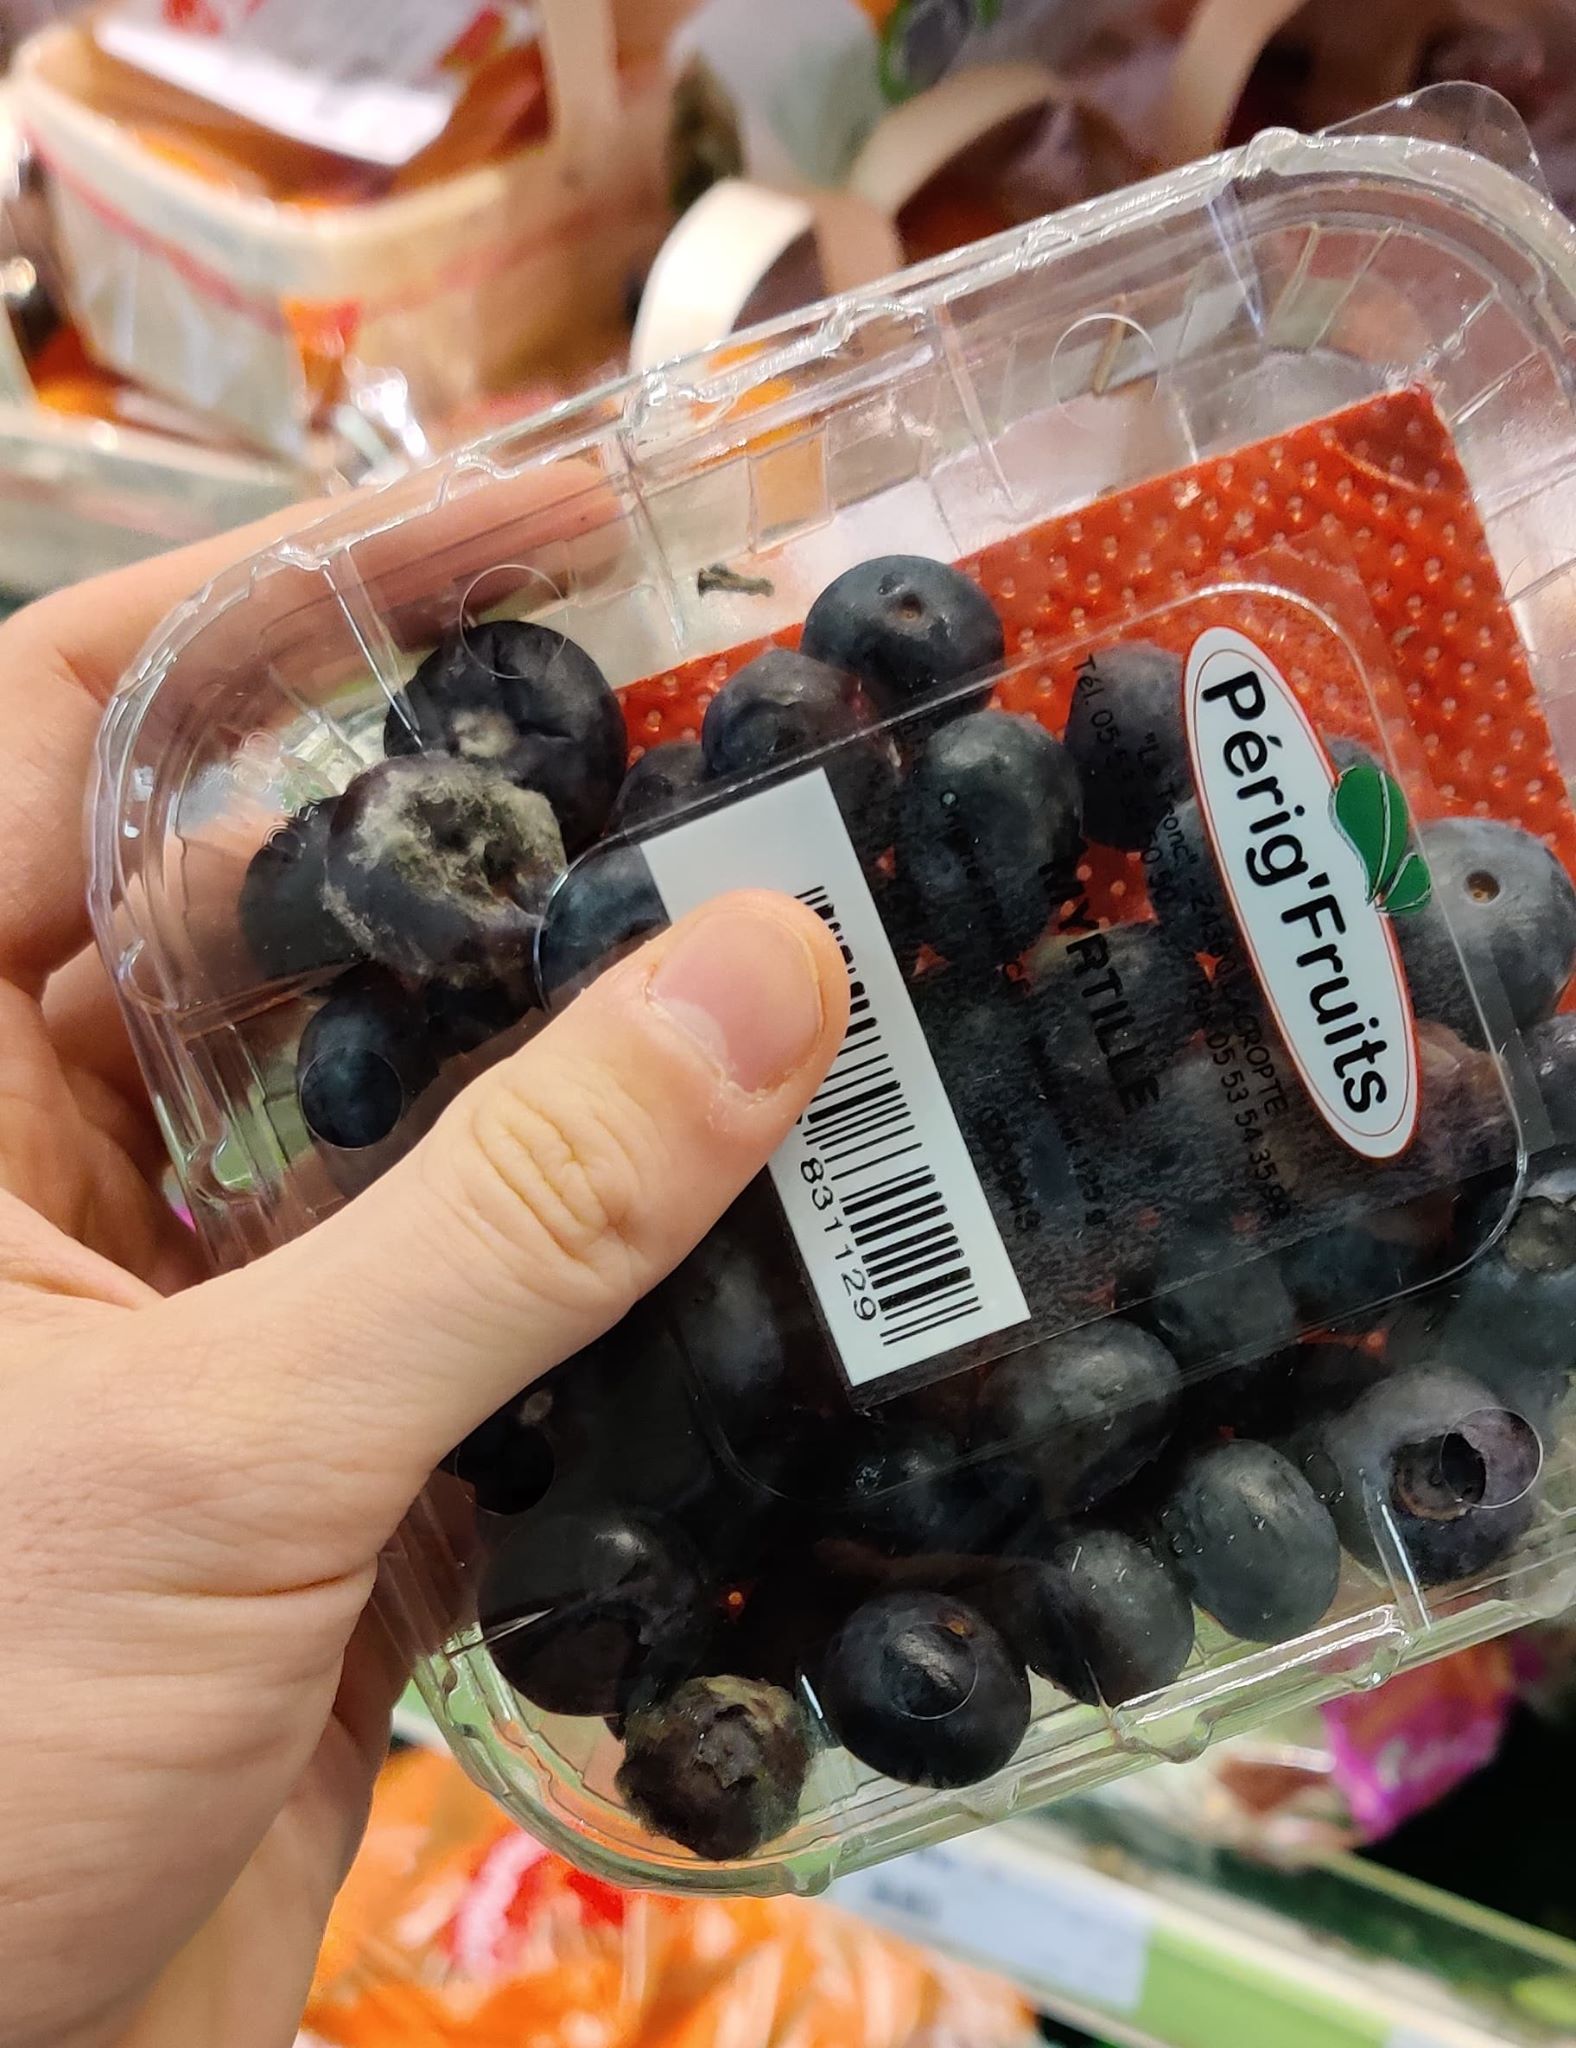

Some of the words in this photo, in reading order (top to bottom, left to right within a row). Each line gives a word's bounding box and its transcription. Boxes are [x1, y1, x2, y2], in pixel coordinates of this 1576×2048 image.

[1070, 654, 1105, 705] Tél.
[1089, 707, 1120, 746] 05
[1201, 671, 1387, 1114] Périg'Fruits
[1037, 853, 1163, 1115] MYRTILLE
[1205, 1029, 1236, 1067] 05
[1220, 1069, 1249, 1104] 53
[1235, 1107, 1264, 1144] 54
[1248, 1147, 1277, 1182] 35
[800, 1156, 877, 1321] 831129
